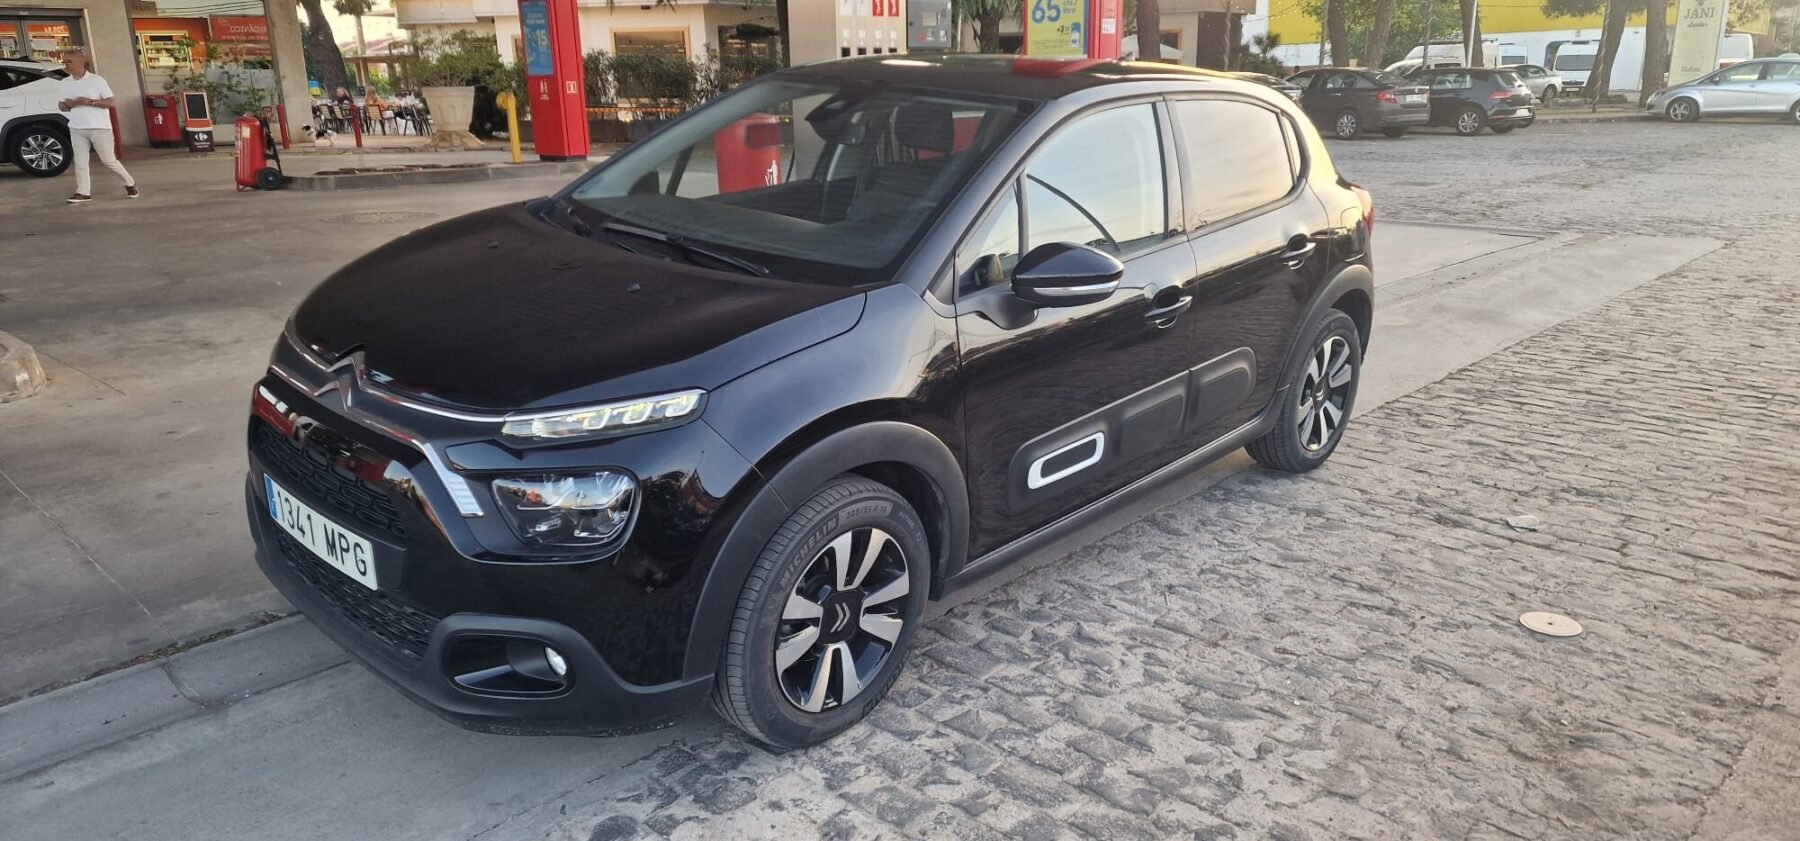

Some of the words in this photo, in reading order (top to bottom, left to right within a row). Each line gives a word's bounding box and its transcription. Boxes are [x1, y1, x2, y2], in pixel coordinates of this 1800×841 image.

[1032, 0, 1061, 24] 65
[1683, 7, 1716, 19] JANI
[536, 29, 548, 47] 15
[846, 504, 872, 519] 205/55
[277, 490, 315, 546] 1341
[323, 523, 367, 577] MPG
[779, 517, 837, 589] MICHELIN
